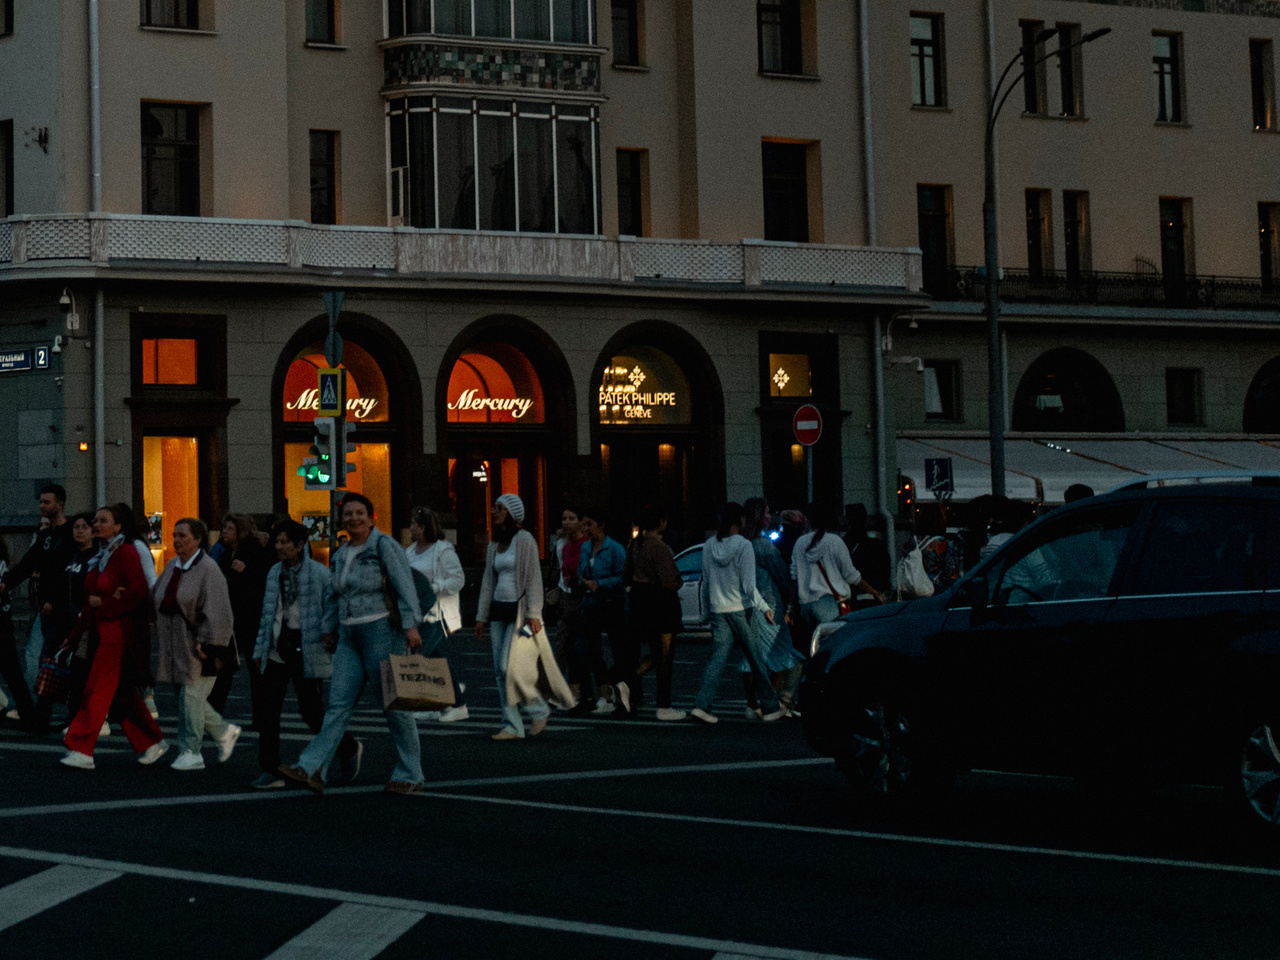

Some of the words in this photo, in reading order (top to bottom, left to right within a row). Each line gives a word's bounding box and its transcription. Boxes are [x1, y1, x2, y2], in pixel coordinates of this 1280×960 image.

[38, 350, 45, 365] 2
[286, 388, 379, 419] Meury
[447, 388, 534, 419] Mercury
[599, 392, 631, 405] PATEK
[631, 392, 676, 406] PHILIPPE
